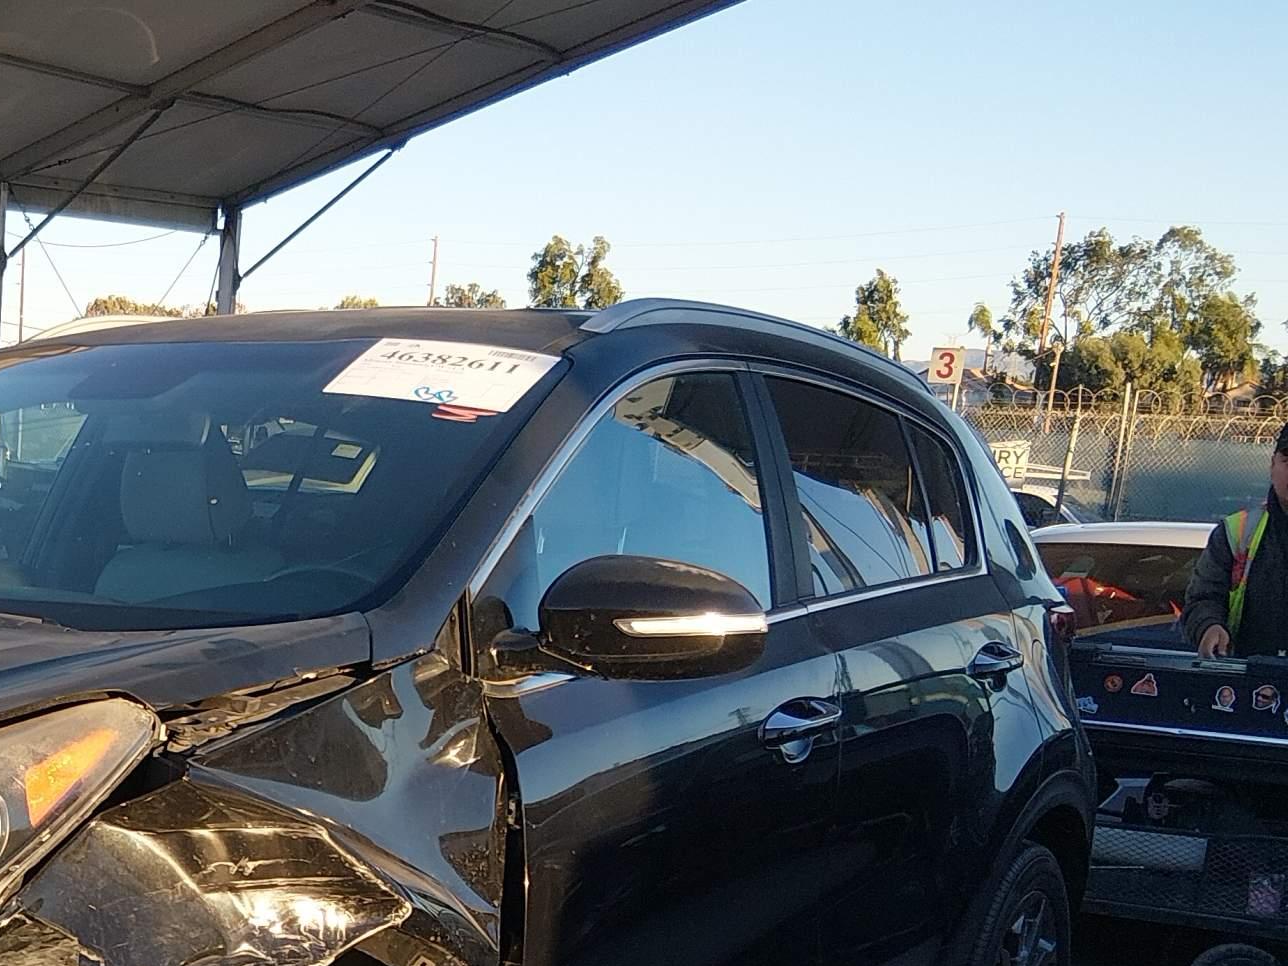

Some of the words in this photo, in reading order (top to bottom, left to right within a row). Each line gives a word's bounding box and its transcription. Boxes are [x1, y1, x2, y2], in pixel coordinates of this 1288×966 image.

[379, 350, 521, 374] 46382611
[935, 351, 955, 379] 3
[993, 449, 1026, 465] RY
